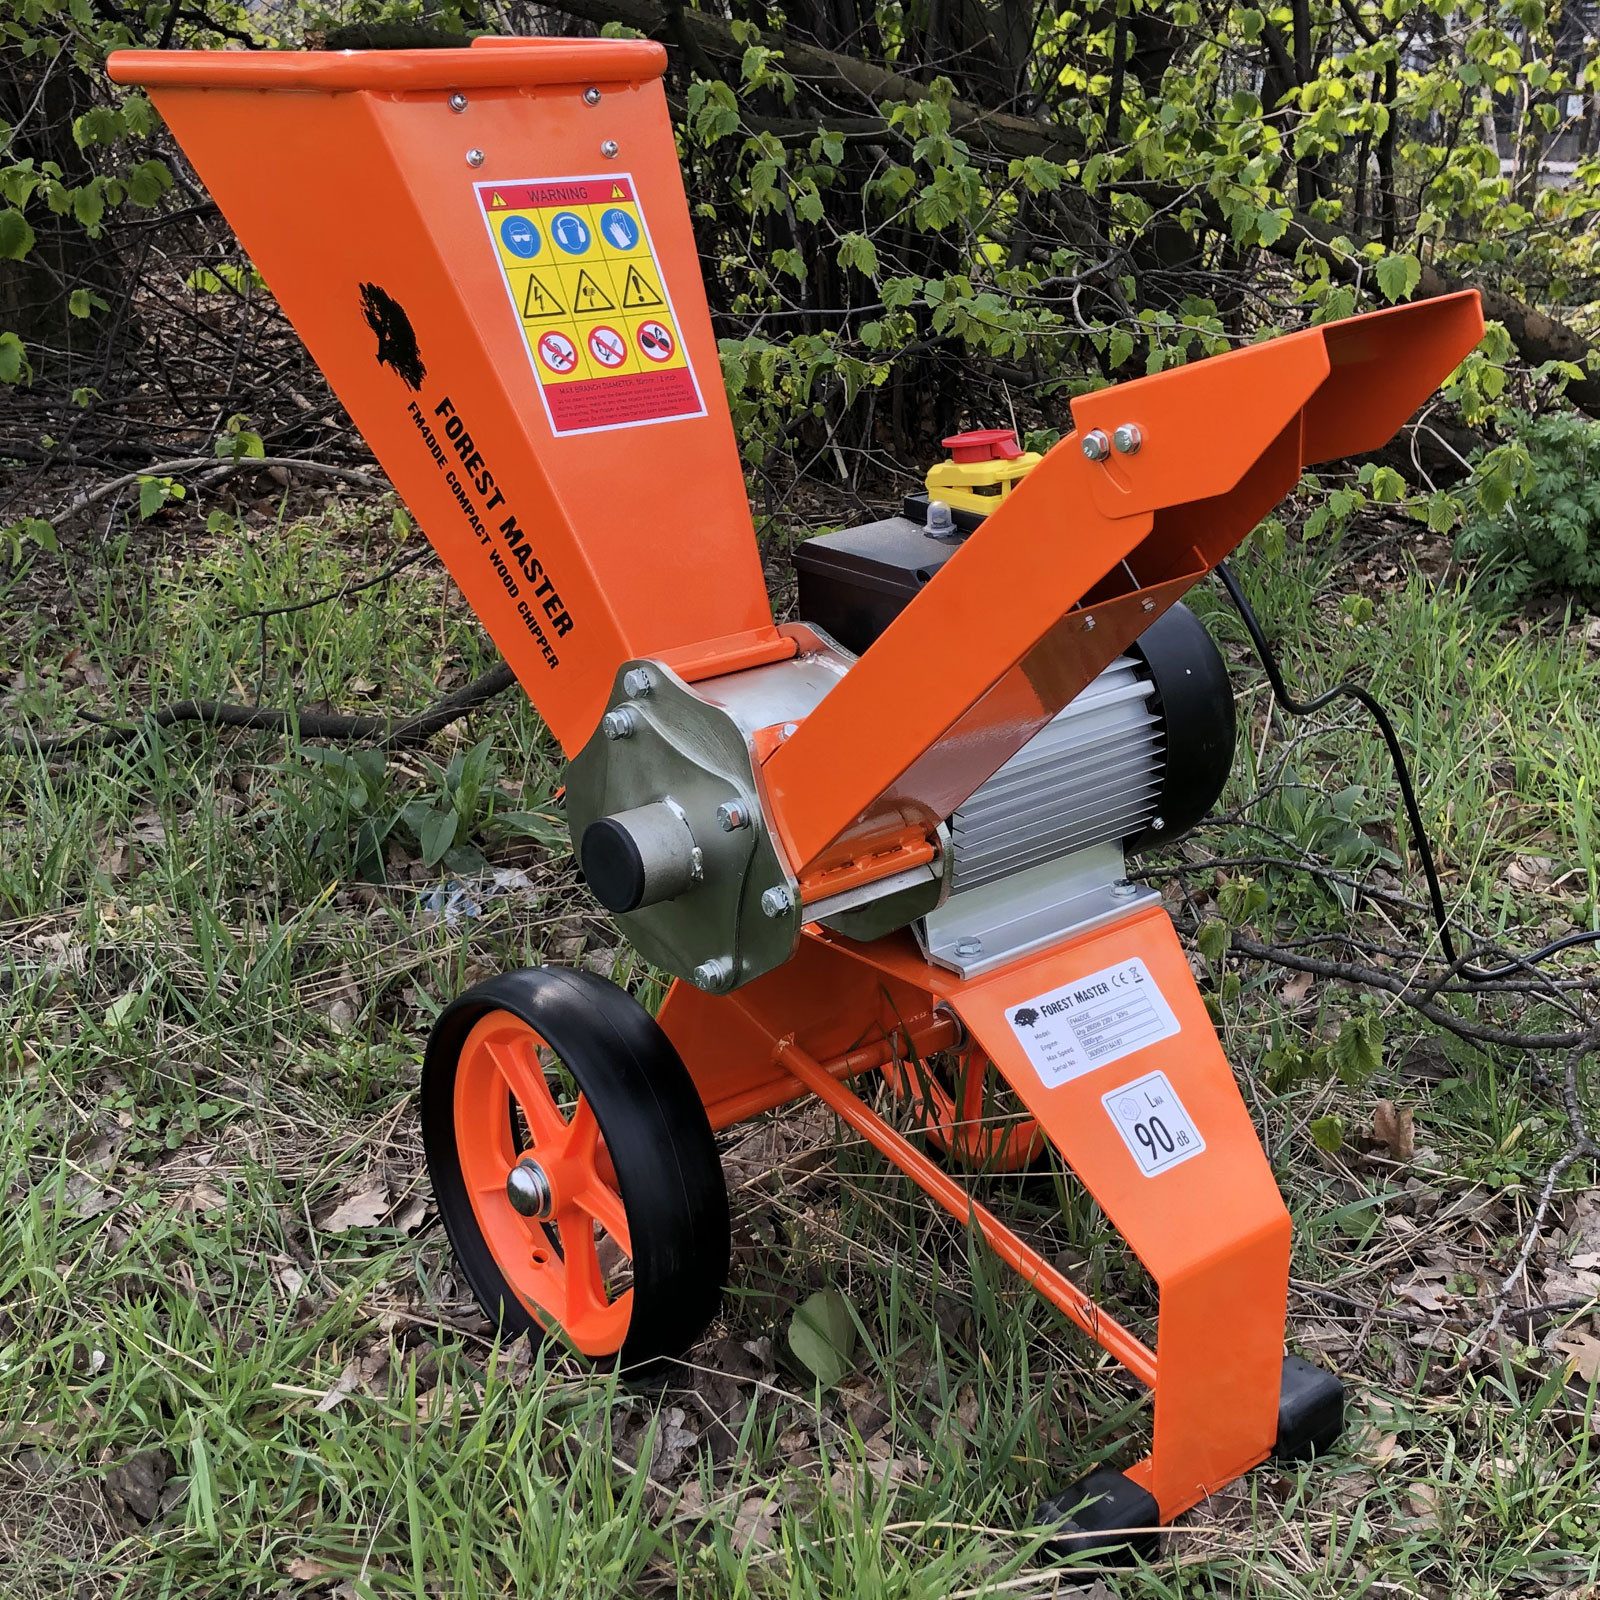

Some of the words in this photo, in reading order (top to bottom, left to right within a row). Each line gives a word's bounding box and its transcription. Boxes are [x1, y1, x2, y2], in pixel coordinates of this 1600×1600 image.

[527, 187, 588, 203] WARNING
[575, 384, 602, 394] BRANCH
[408, 401, 448, 470] FM4DDE
[446, 471, 491, 546] COMPACT
[490, 549, 519, 598] WOOD
[517, 601, 559, 670] CHIPPER
[434, 397, 505, 511] FOREST
[500, 516, 574, 638] MASTER
[1040, 996, 1074, 1017] FOREST
[1073, 983, 1110, 1004] MASTER
[1134, 1116, 1174, 1160] 90
[1176, 1130, 1190, 1146] dB
